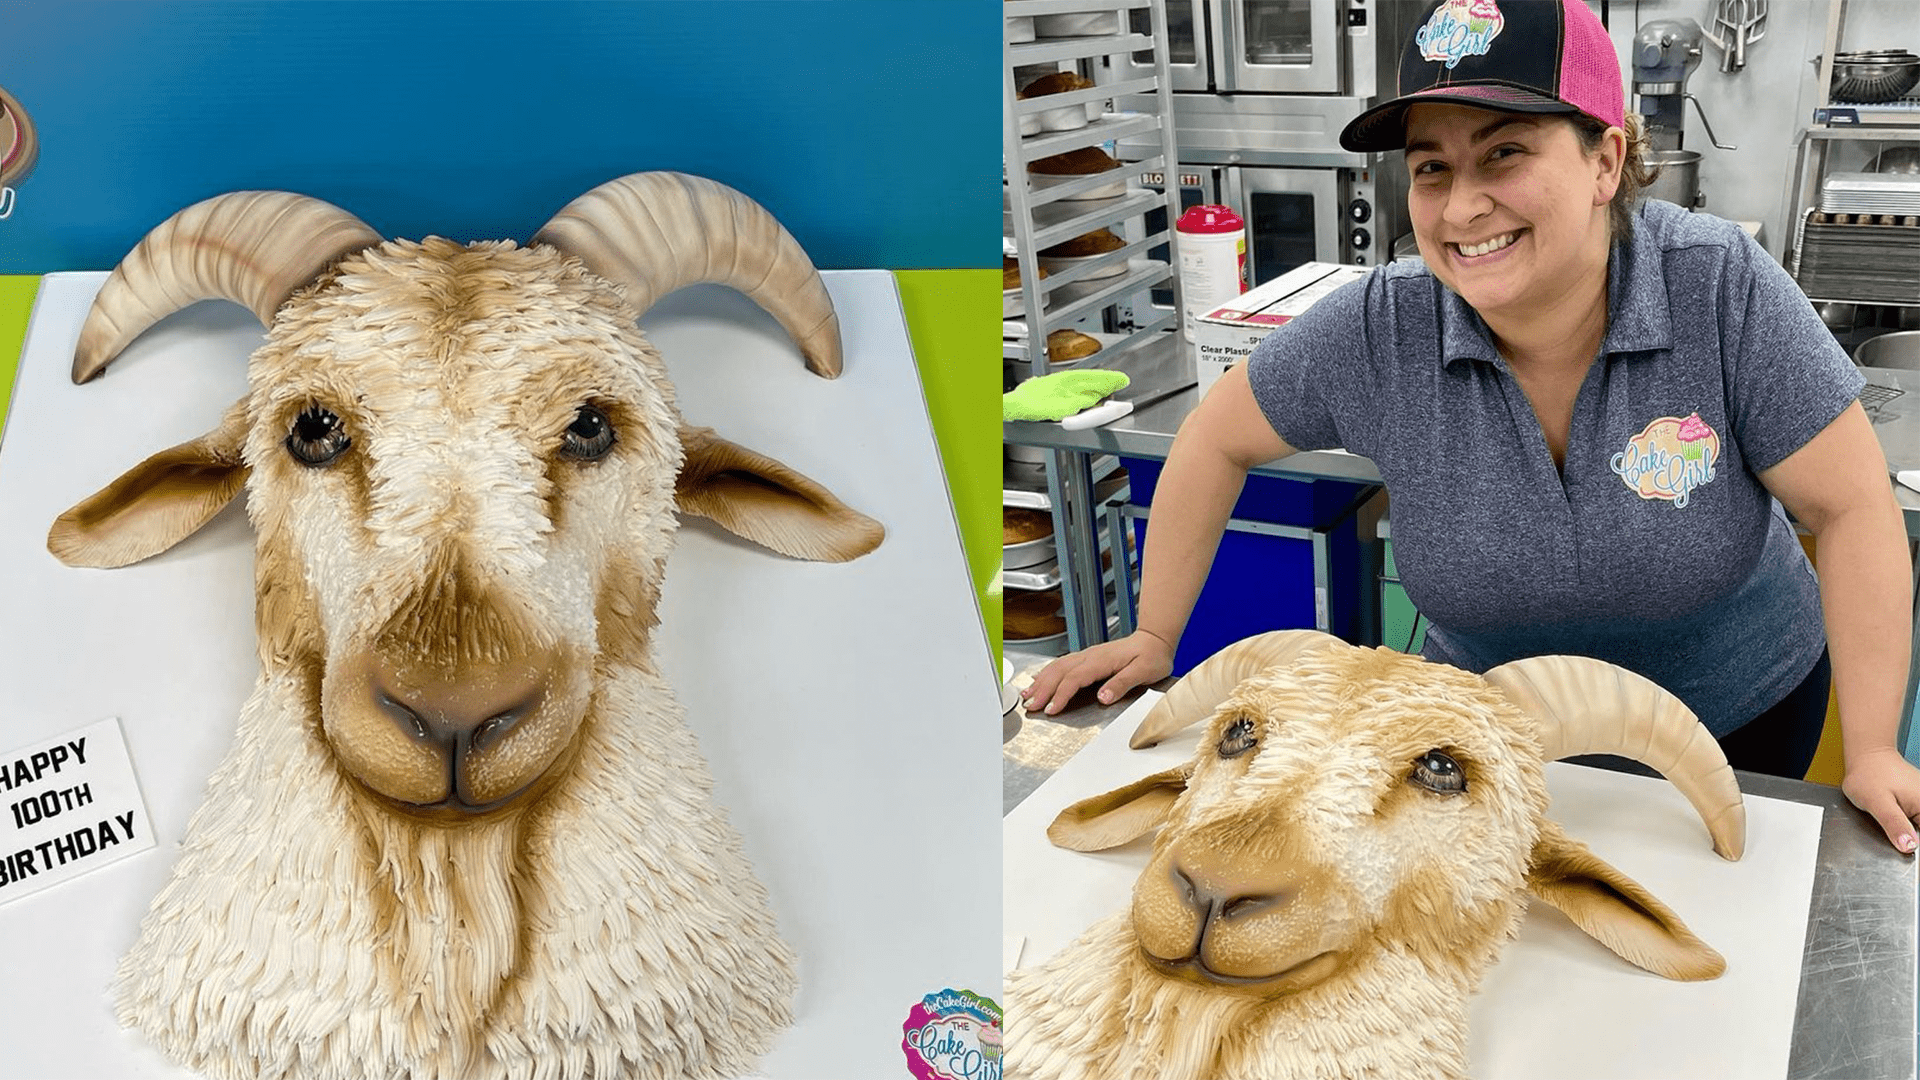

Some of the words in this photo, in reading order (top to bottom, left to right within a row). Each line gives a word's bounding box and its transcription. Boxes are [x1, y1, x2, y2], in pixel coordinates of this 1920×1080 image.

[1416, 11, 1456, 54] Cake
[1437, 24, 1492, 68] Girl
[1142, 173, 1198, 185] BLOETT
[1200, 345, 1223, 354] Clear
[1249, 336, 1265, 345] SP1
[1653, 425, 1671, 438] THE
[1611, 441, 1667, 488] Cake
[1654, 447, 1716, 507] Girl
[0, 737, 87, 793] HAPPY
[10, 782, 94, 830] 100TH
[908, 1024, 967, 1066] Cake
[951, 1021, 970, 1031] THE
